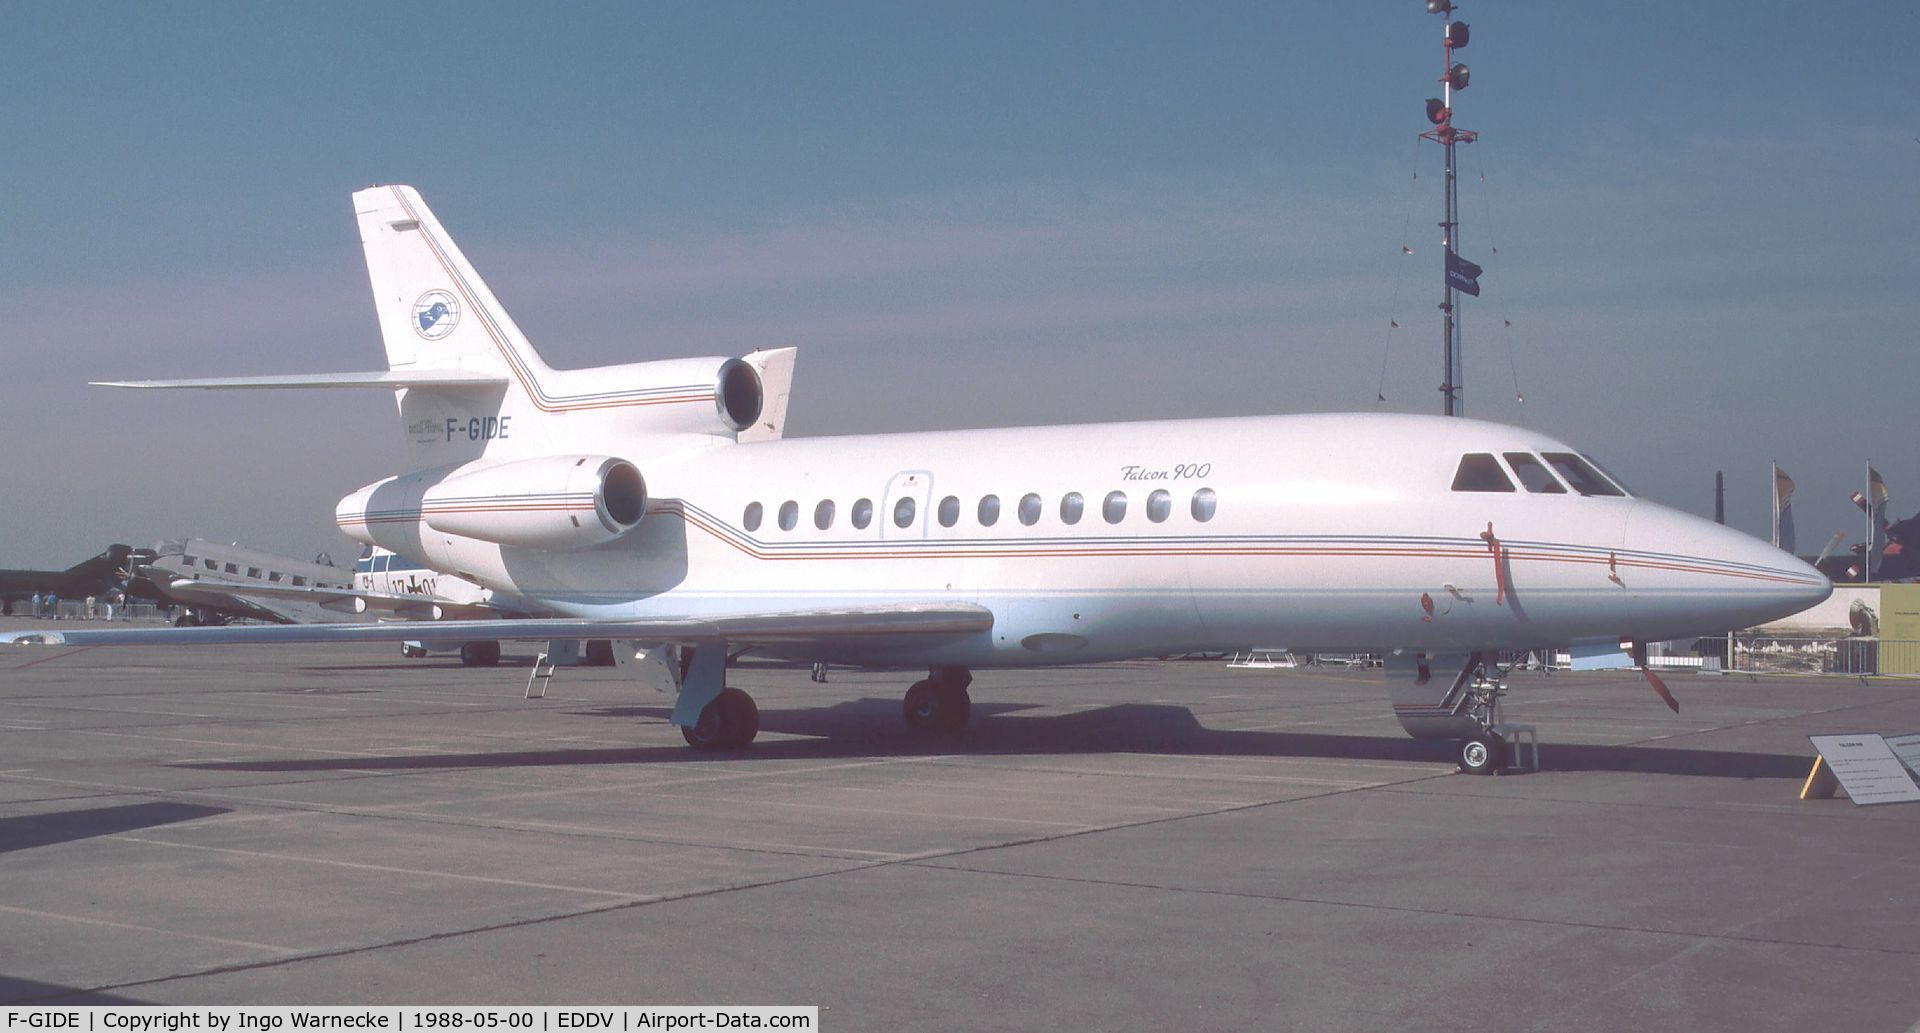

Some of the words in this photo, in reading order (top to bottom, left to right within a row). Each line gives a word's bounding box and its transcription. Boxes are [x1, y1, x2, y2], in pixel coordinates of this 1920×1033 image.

[446, 417, 511, 442] F-GIDE
[1120, 465, 1169, 481] Falcon
[1173, 463, 1212, 481] 900
